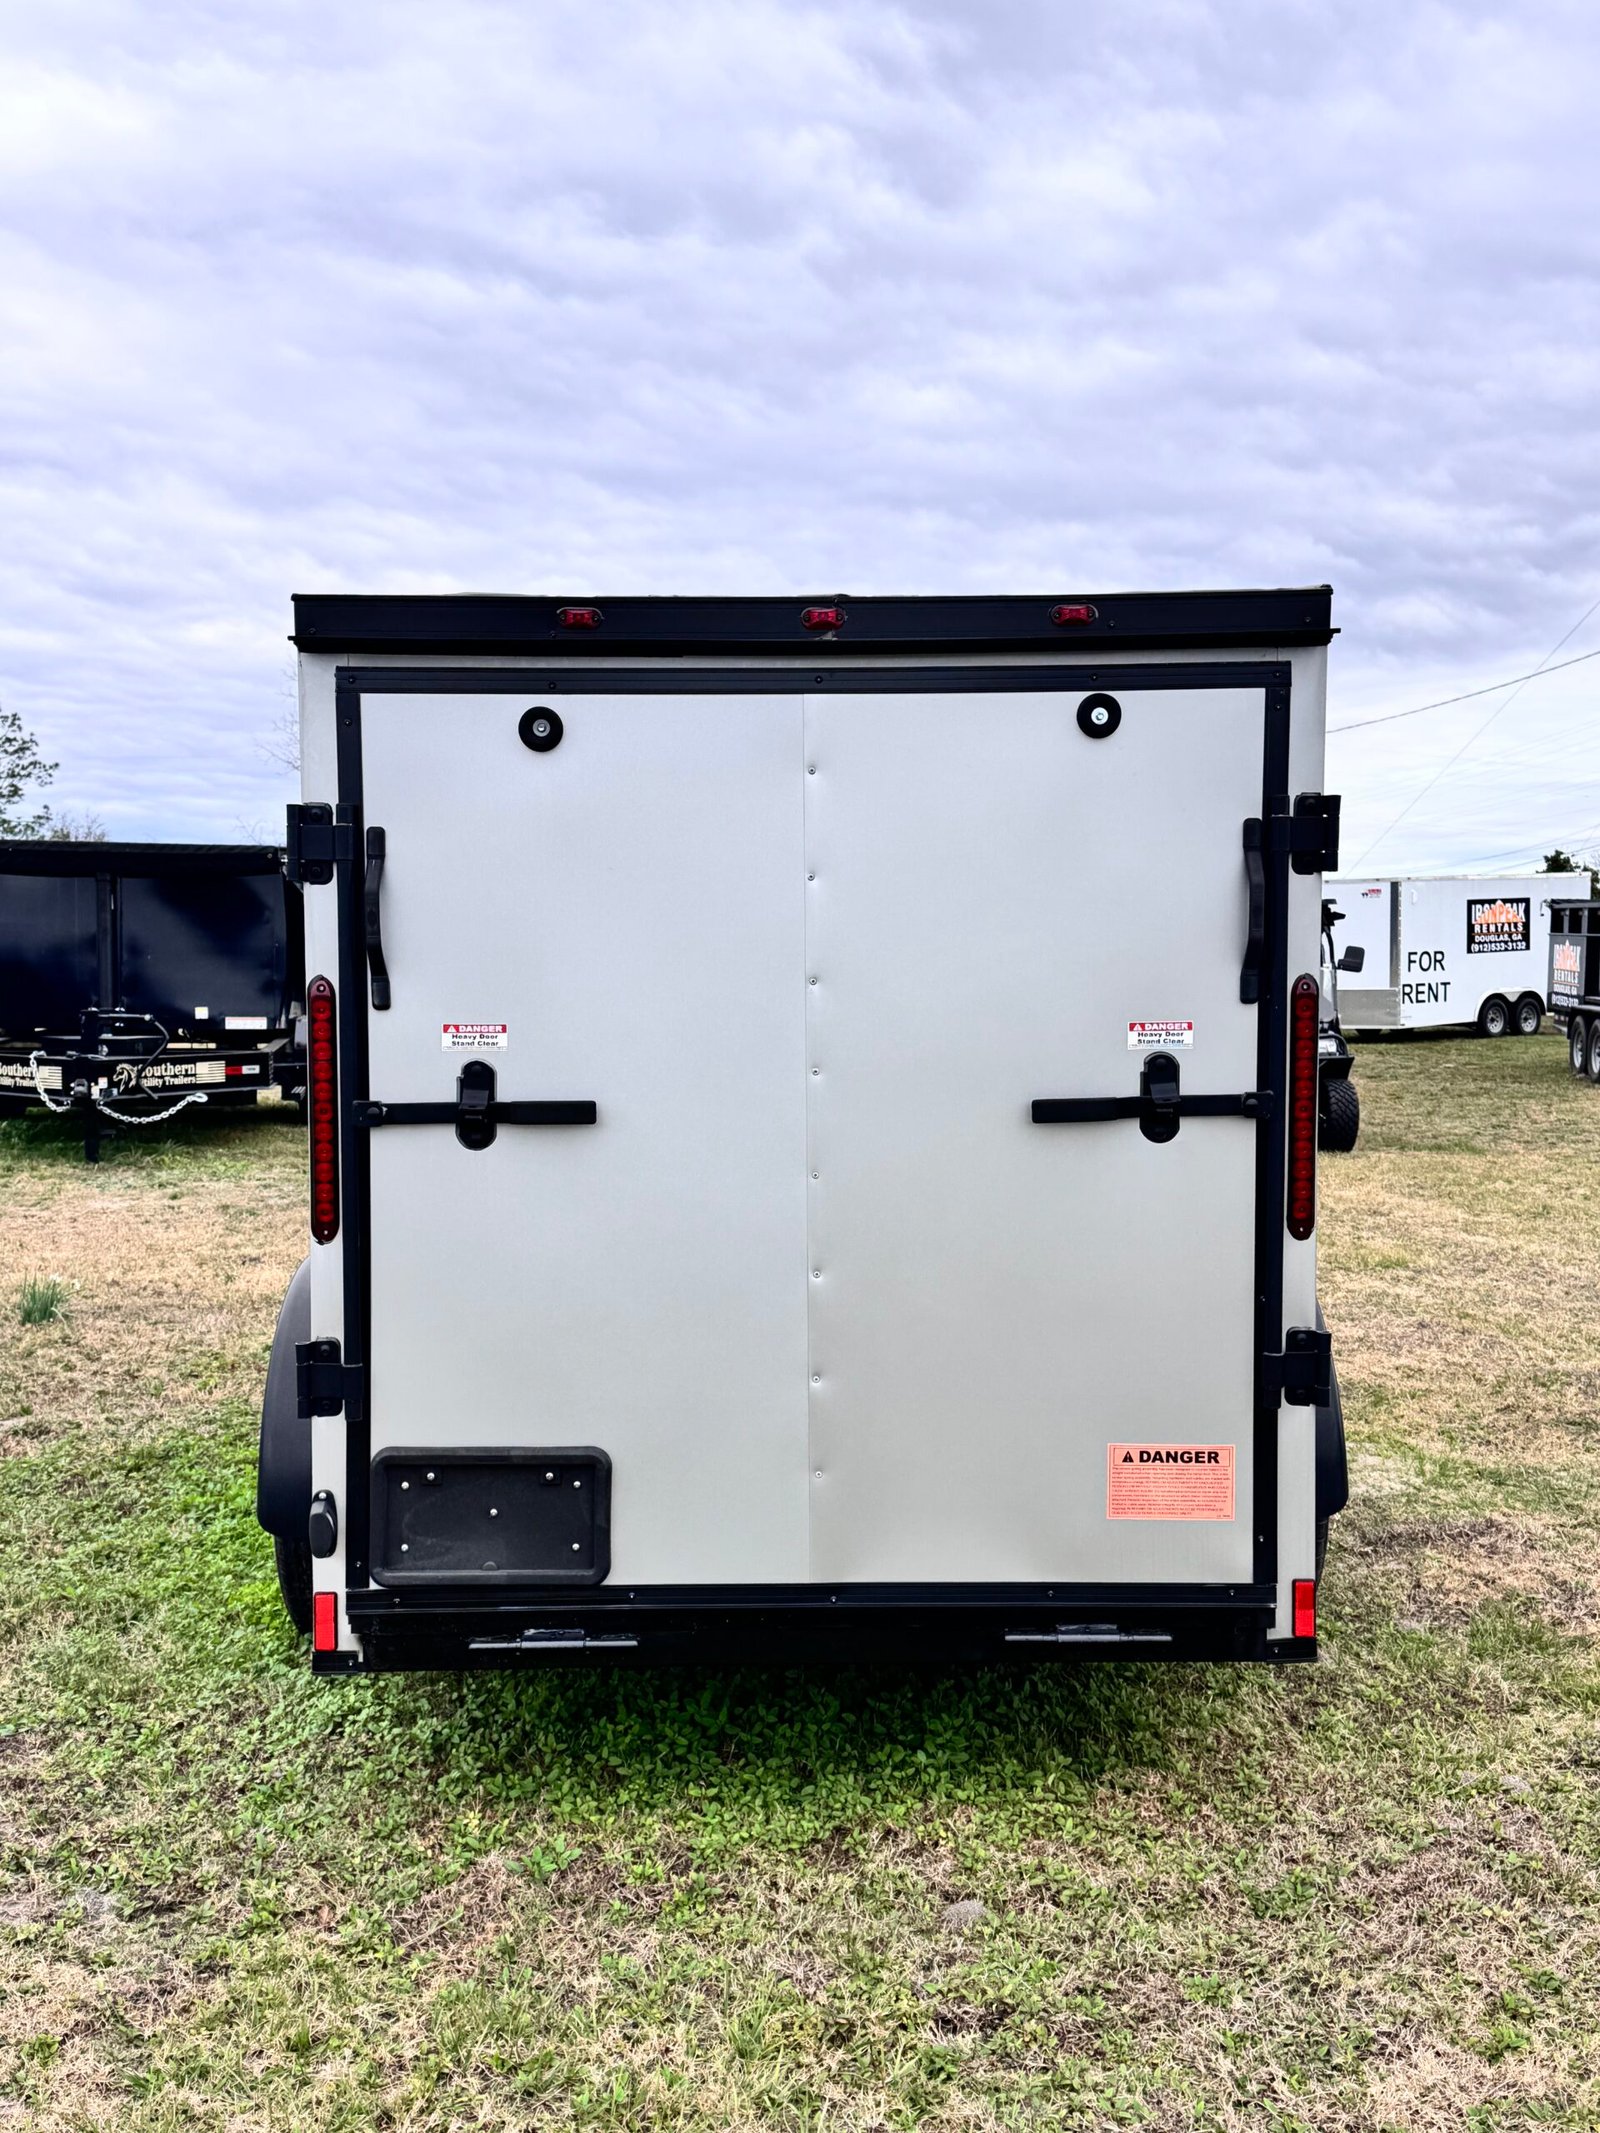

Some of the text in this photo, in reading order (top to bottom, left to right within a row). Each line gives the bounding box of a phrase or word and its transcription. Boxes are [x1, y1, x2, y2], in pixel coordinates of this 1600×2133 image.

[1474, 922, 1523, 934] RENTALS
[1511, 933, 1523, 941] GA
[1408, 950, 1446, 972] FOR
[1401, 981, 1451, 1004] RENT
[458, 1025, 503, 1033] DANGER
[1144, 1023, 1189, 1031] DANGER
[164, 1075, 196, 1086] Trailers
[1139, 1450, 1220, 1464] DANGER
